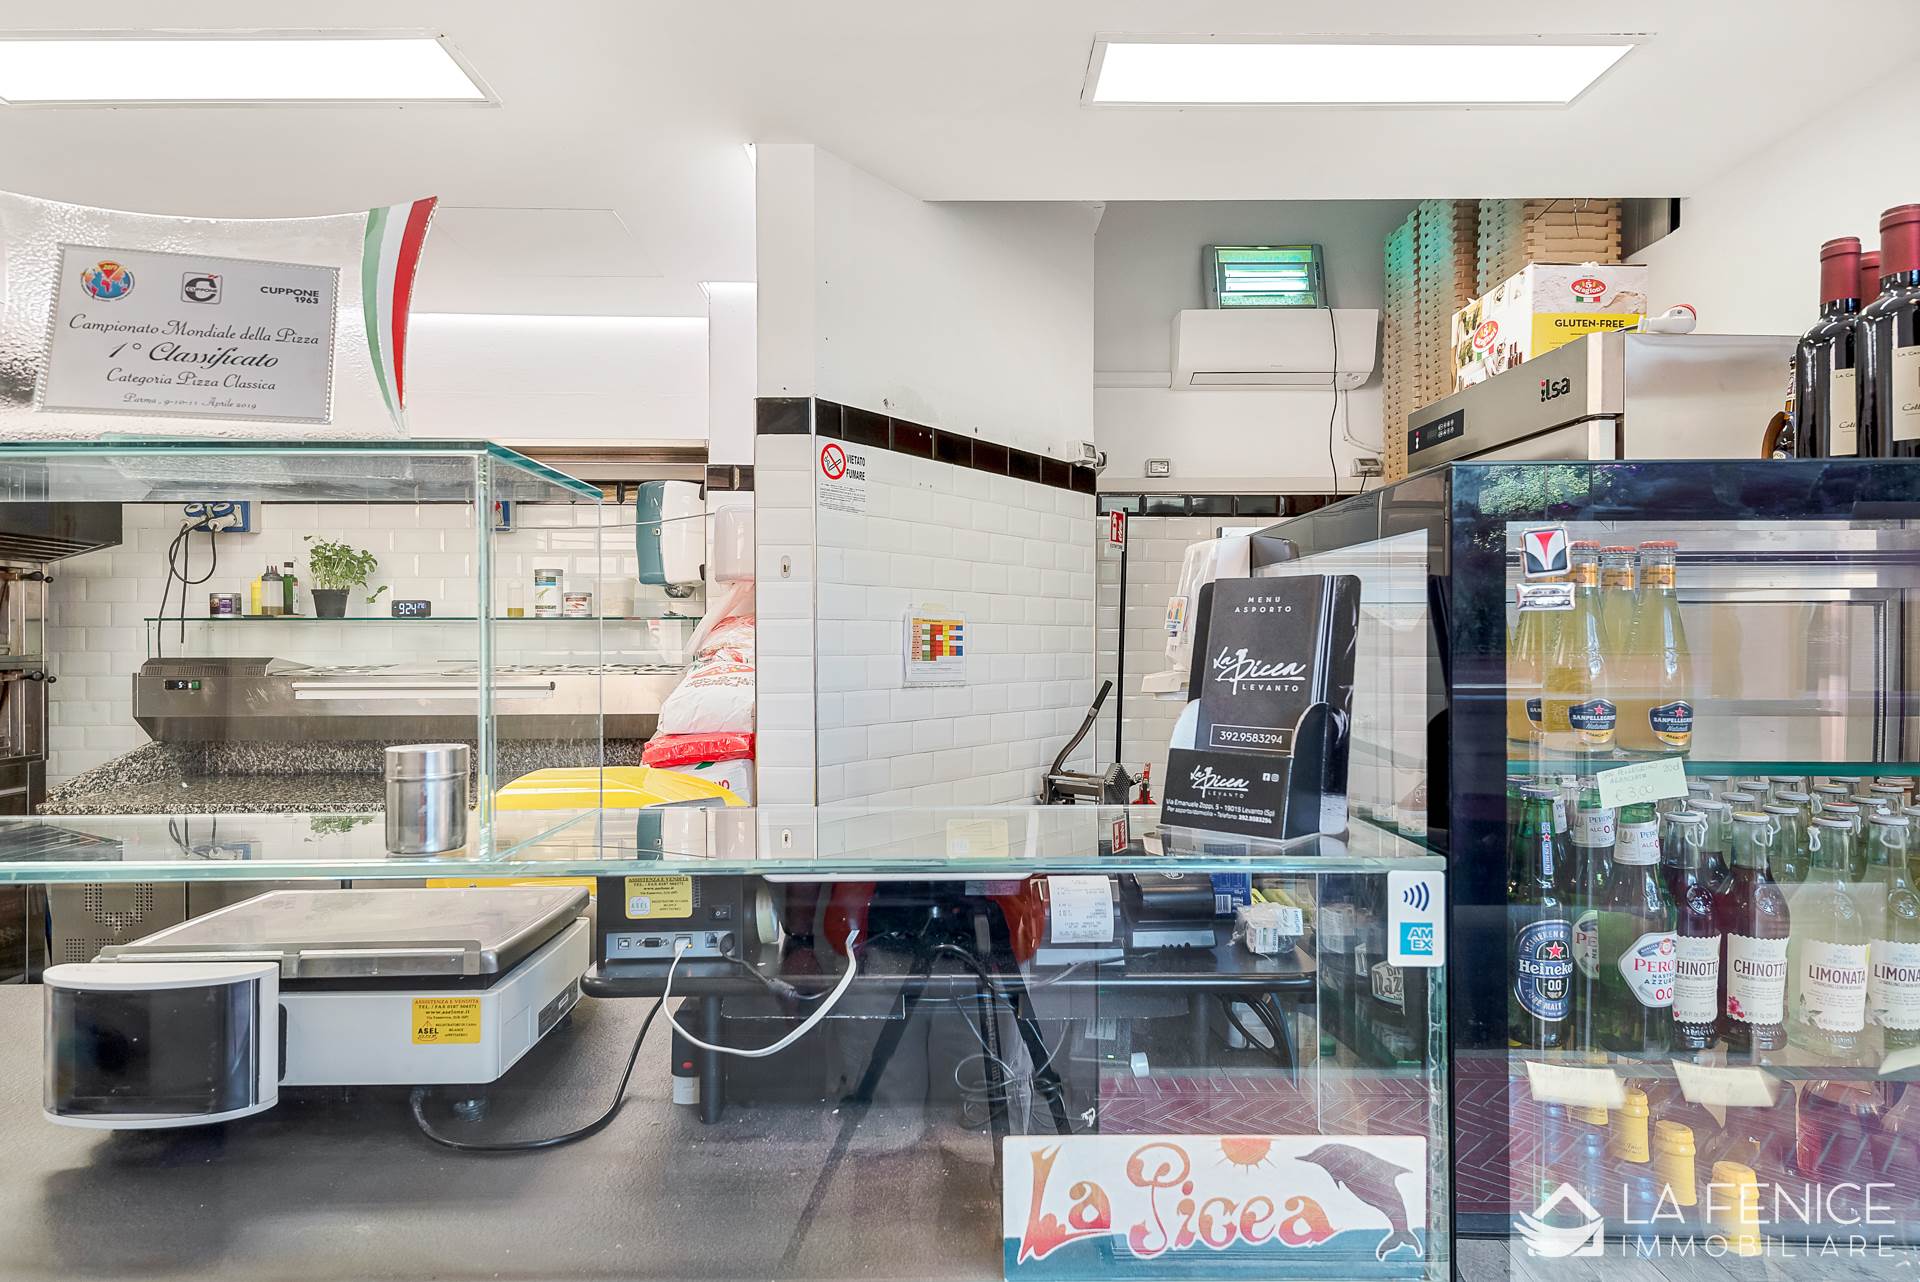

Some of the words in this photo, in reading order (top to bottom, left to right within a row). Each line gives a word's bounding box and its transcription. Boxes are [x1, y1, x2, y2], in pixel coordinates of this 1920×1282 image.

[260, 285, 320, 298] CUPPONE
[294, 296, 319, 305] 1963
[69, 313, 160, 334] Campionato
[161, 319, 236, 340] Mondiale
[239, 326, 271, 342] della
[274, 327, 319, 345] Pizza
[1554, 319, 1625, 328] GLUTEN-FREE
[149, 341, 279, 369] Classificato
[106, 367, 172, 387] Categoria
[176, 371, 219, 388] Pizza
[223, 373, 276, 391] Classica
[1539, 377, 1571, 402] ilsa
[846, 453, 866, 468] VIETATO
[846, 468, 866, 481] FUMARE
[1234, 605, 1292, 613] ASPORTO
[1213, 646, 1238, 670] La
[1241, 683, 1299, 693] LEVANTO
[1219, 730, 1283, 745] 392.9583294
[1190, 764, 1204, 781] La
[1207, 790, 1245, 799] LEVANTO
[1412, 938, 1433, 950] EX
[417, 1027, 440, 1035] ASEL
[1017, 1143, 1112, 1263] La
[1125, 1140, 1338, 1258] Picea
